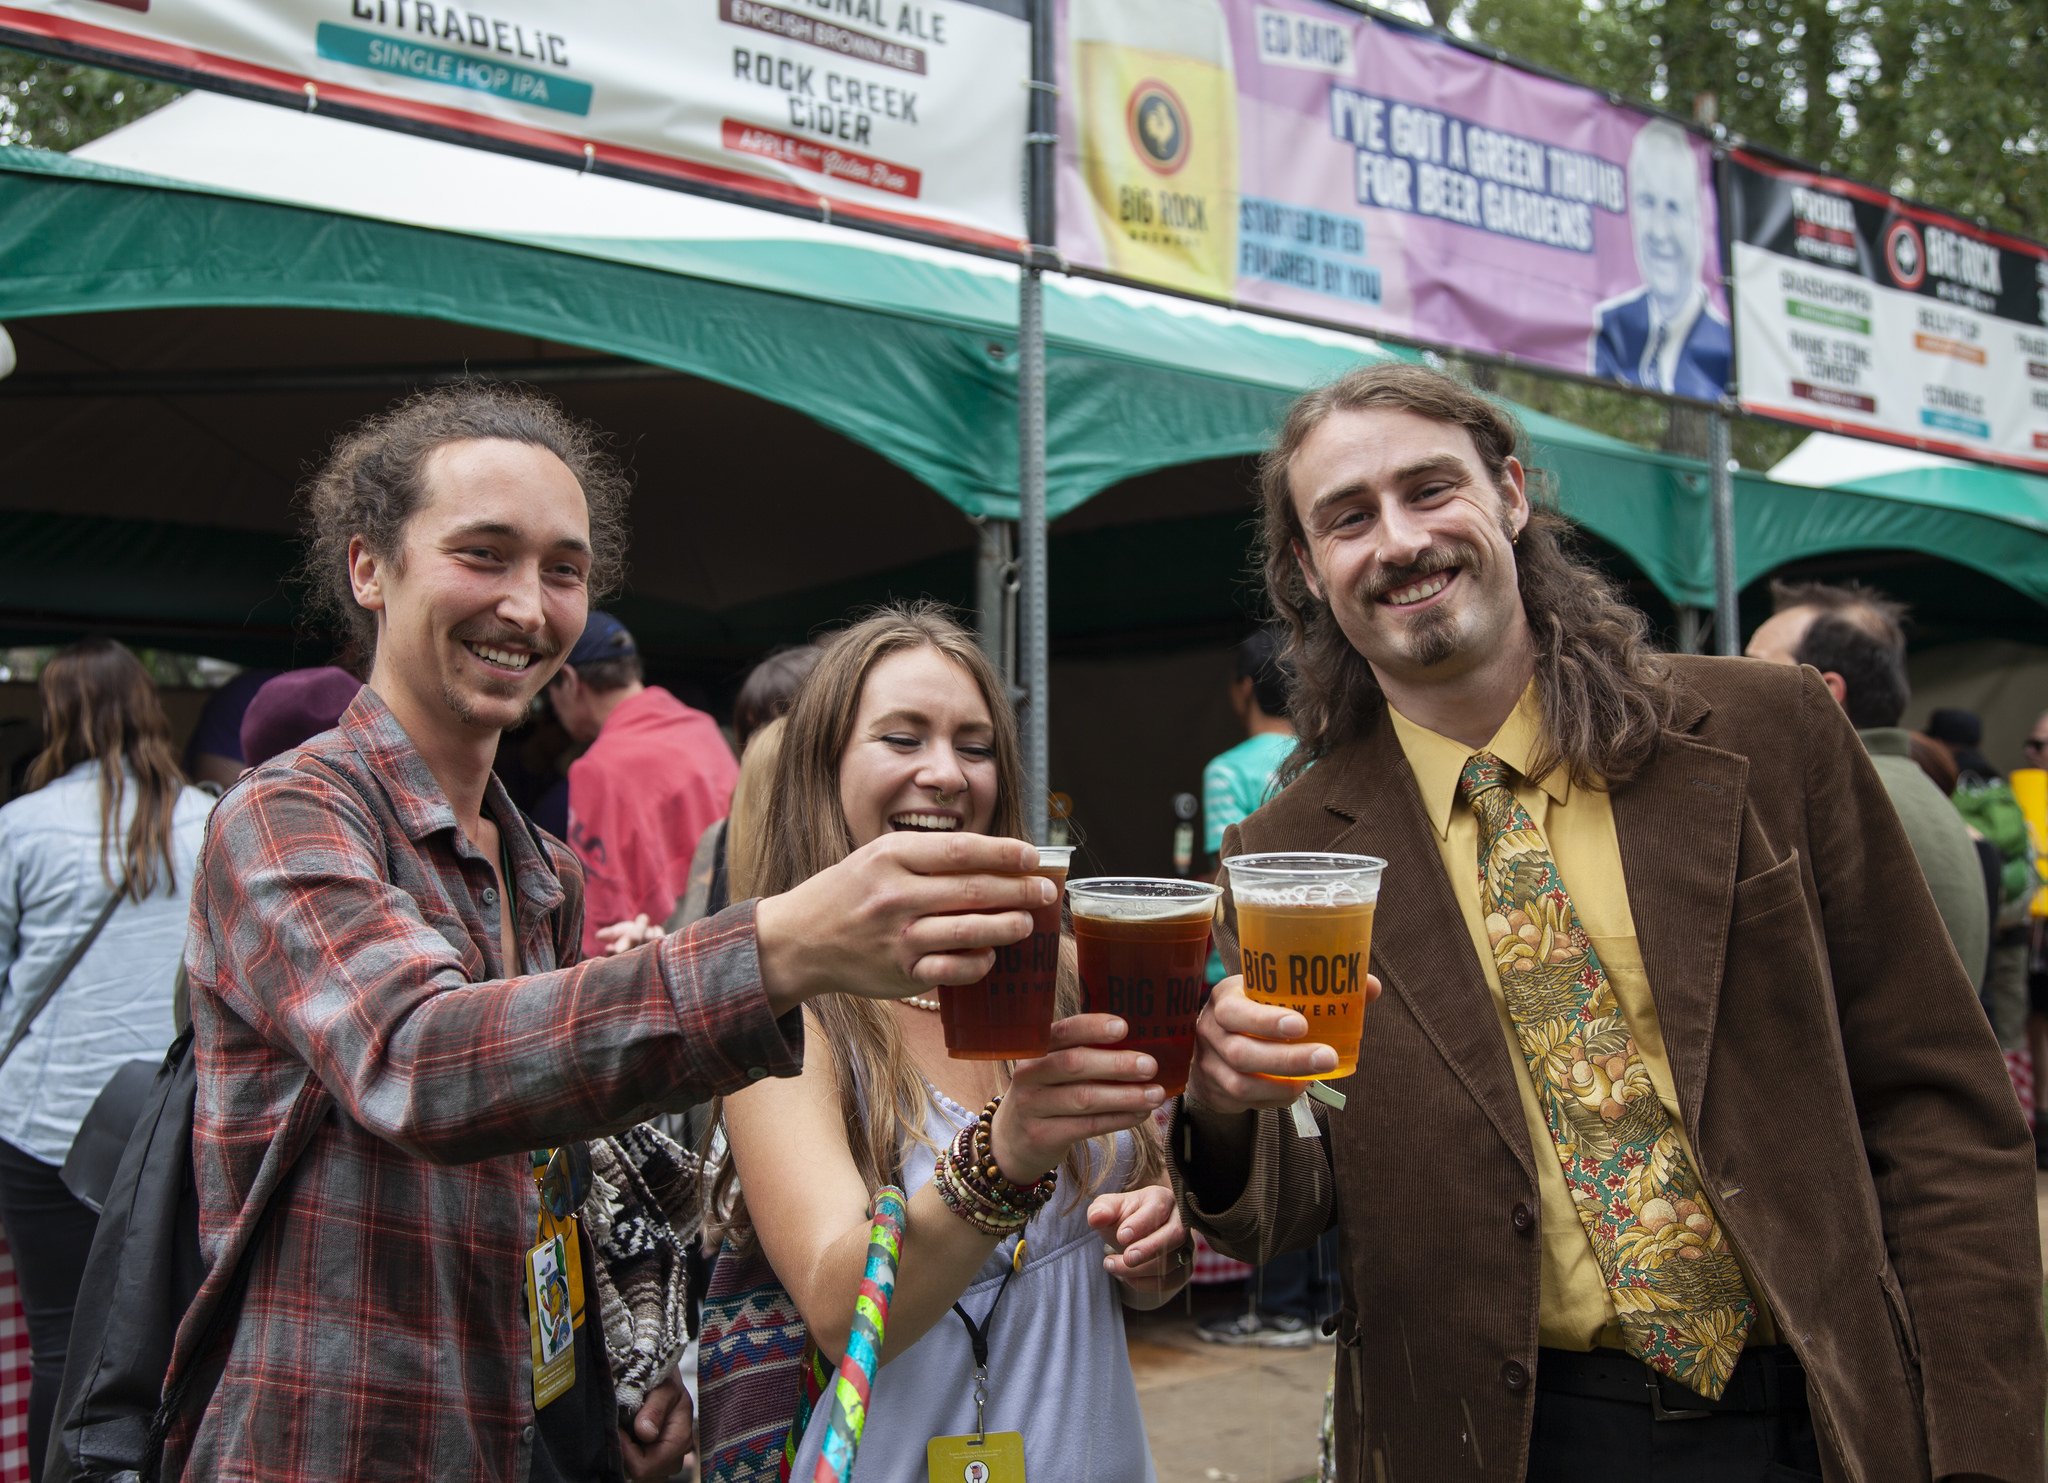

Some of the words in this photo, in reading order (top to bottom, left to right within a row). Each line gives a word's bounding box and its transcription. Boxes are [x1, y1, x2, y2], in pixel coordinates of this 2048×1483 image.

[730, 1, 812, 40] ENGLISH
[814, 22, 883, 60] BROWN
[882, 45, 917, 70] ALE
[898, 4, 947, 44] ALE
[1262, 14, 1290, 54] ED
[368, 39, 453, 80] SINGLE
[457, 58, 508, 91] HOP
[512, 70, 549, 101] IPA
[733, 47, 816, 97] ROCK
[826, 72, 919, 124] CREEK
[739, 128, 796, 161] APPLE
[1330, 87, 1386, 151] I'VE
[1389, 102, 1445, 164] GOT
[1448, 120, 1467, 170] A
[1466, 125, 1545, 193] GREEN
[1547, 147, 1626, 214] THUMB
[1358, 151, 1412, 210] FOR
[1416, 161, 1480, 226] BEER
[1481, 181, 1594, 252] GARDENS
[1289, 952, 1361, 996] ROCK
[1254, 1000, 1350, 1016] WERY
